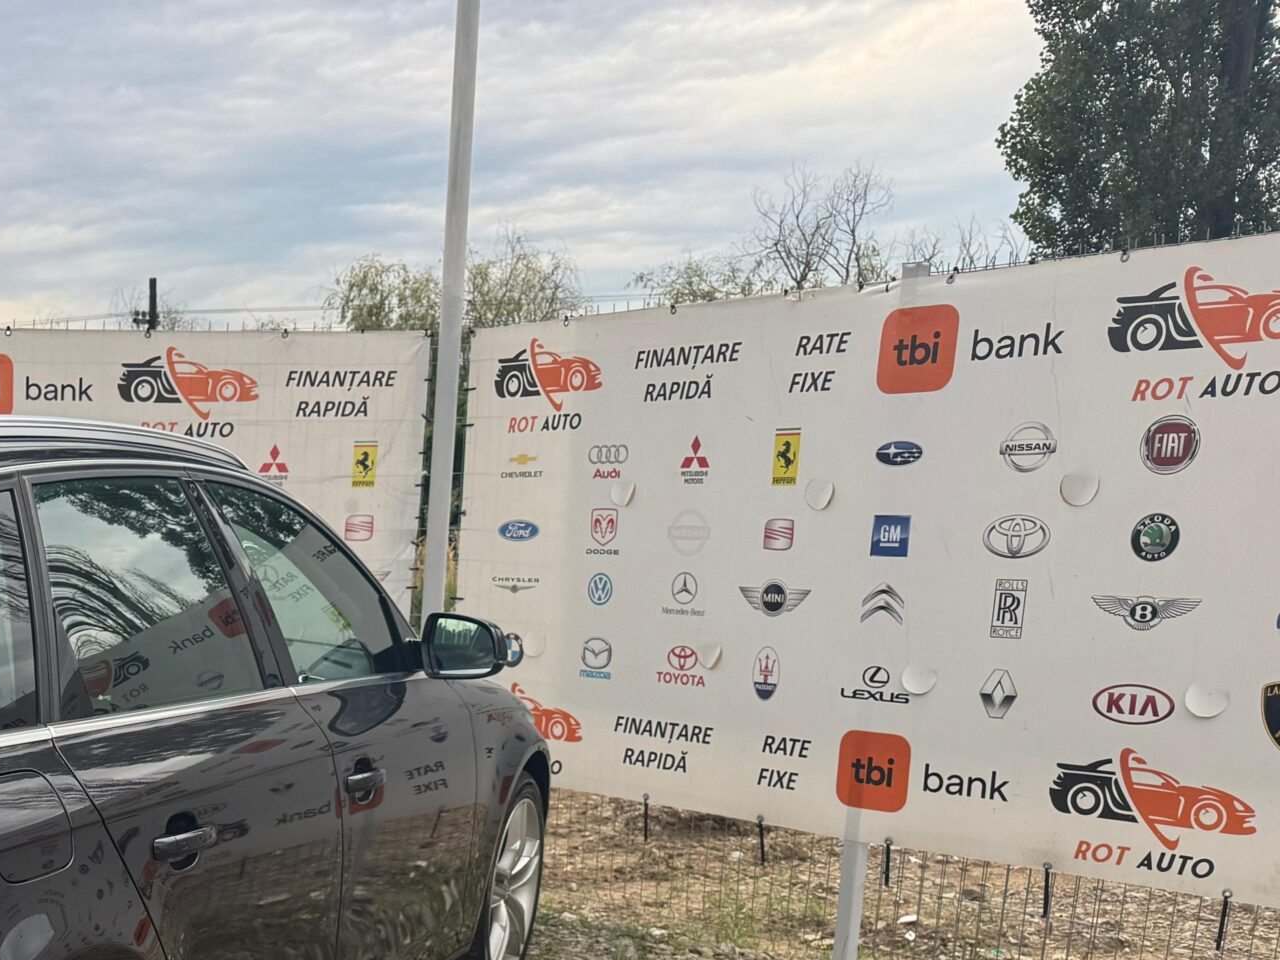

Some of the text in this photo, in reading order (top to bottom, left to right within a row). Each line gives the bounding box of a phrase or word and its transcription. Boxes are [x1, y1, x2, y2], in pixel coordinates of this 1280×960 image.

[796, 332, 851, 356] RATE
[893, 322, 1065, 367] tbi bank
[635, 341, 742, 370] FINANȚARE
[26, 377, 93, 402] bank
[286, 370, 398, 392] FINANȚARE
[644, 374, 713, 402] RAPIDĂ
[789, 371, 836, 394] FIXE
[1131, 370, 1280, 401] ROT AUTO
[295, 395, 369, 417] RAPIDĂ
[184, 422, 235, 438] AUTO
[507, 413, 582, 433] ROT AUTO
[1005, 442, 1051, 452] NISSAN
[1152, 433, 1188, 458] FIAT
[500, 471, 544, 479] CHEVROLET
[592, 468, 620, 479] Audi
[505, 521, 531, 538] Ford
[880, 525, 901, 542] GM
[586, 548, 619, 556] DODGE
[1139, 551, 1166, 560] AUTO
[998, 581, 1025, 590] ROLLS
[763, 593, 785, 603] MINI
[992, 628, 1019, 638] ROYCE
[579, 669, 611, 680] mazda
[656, 672, 705, 687] TOYOTA
[840, 688, 910, 704] LEXUS
[1106, 692, 1160, 717] KIA
[614, 716, 714, 746] FINANȚARE
[762, 735, 811, 758] RATE
[623, 748, 689, 774] RAPIDĂ
[757, 768, 799, 790] FIXE
[851, 757, 1010, 801] tbi bank
[1074, 841, 1215, 879] ROT AUTO
